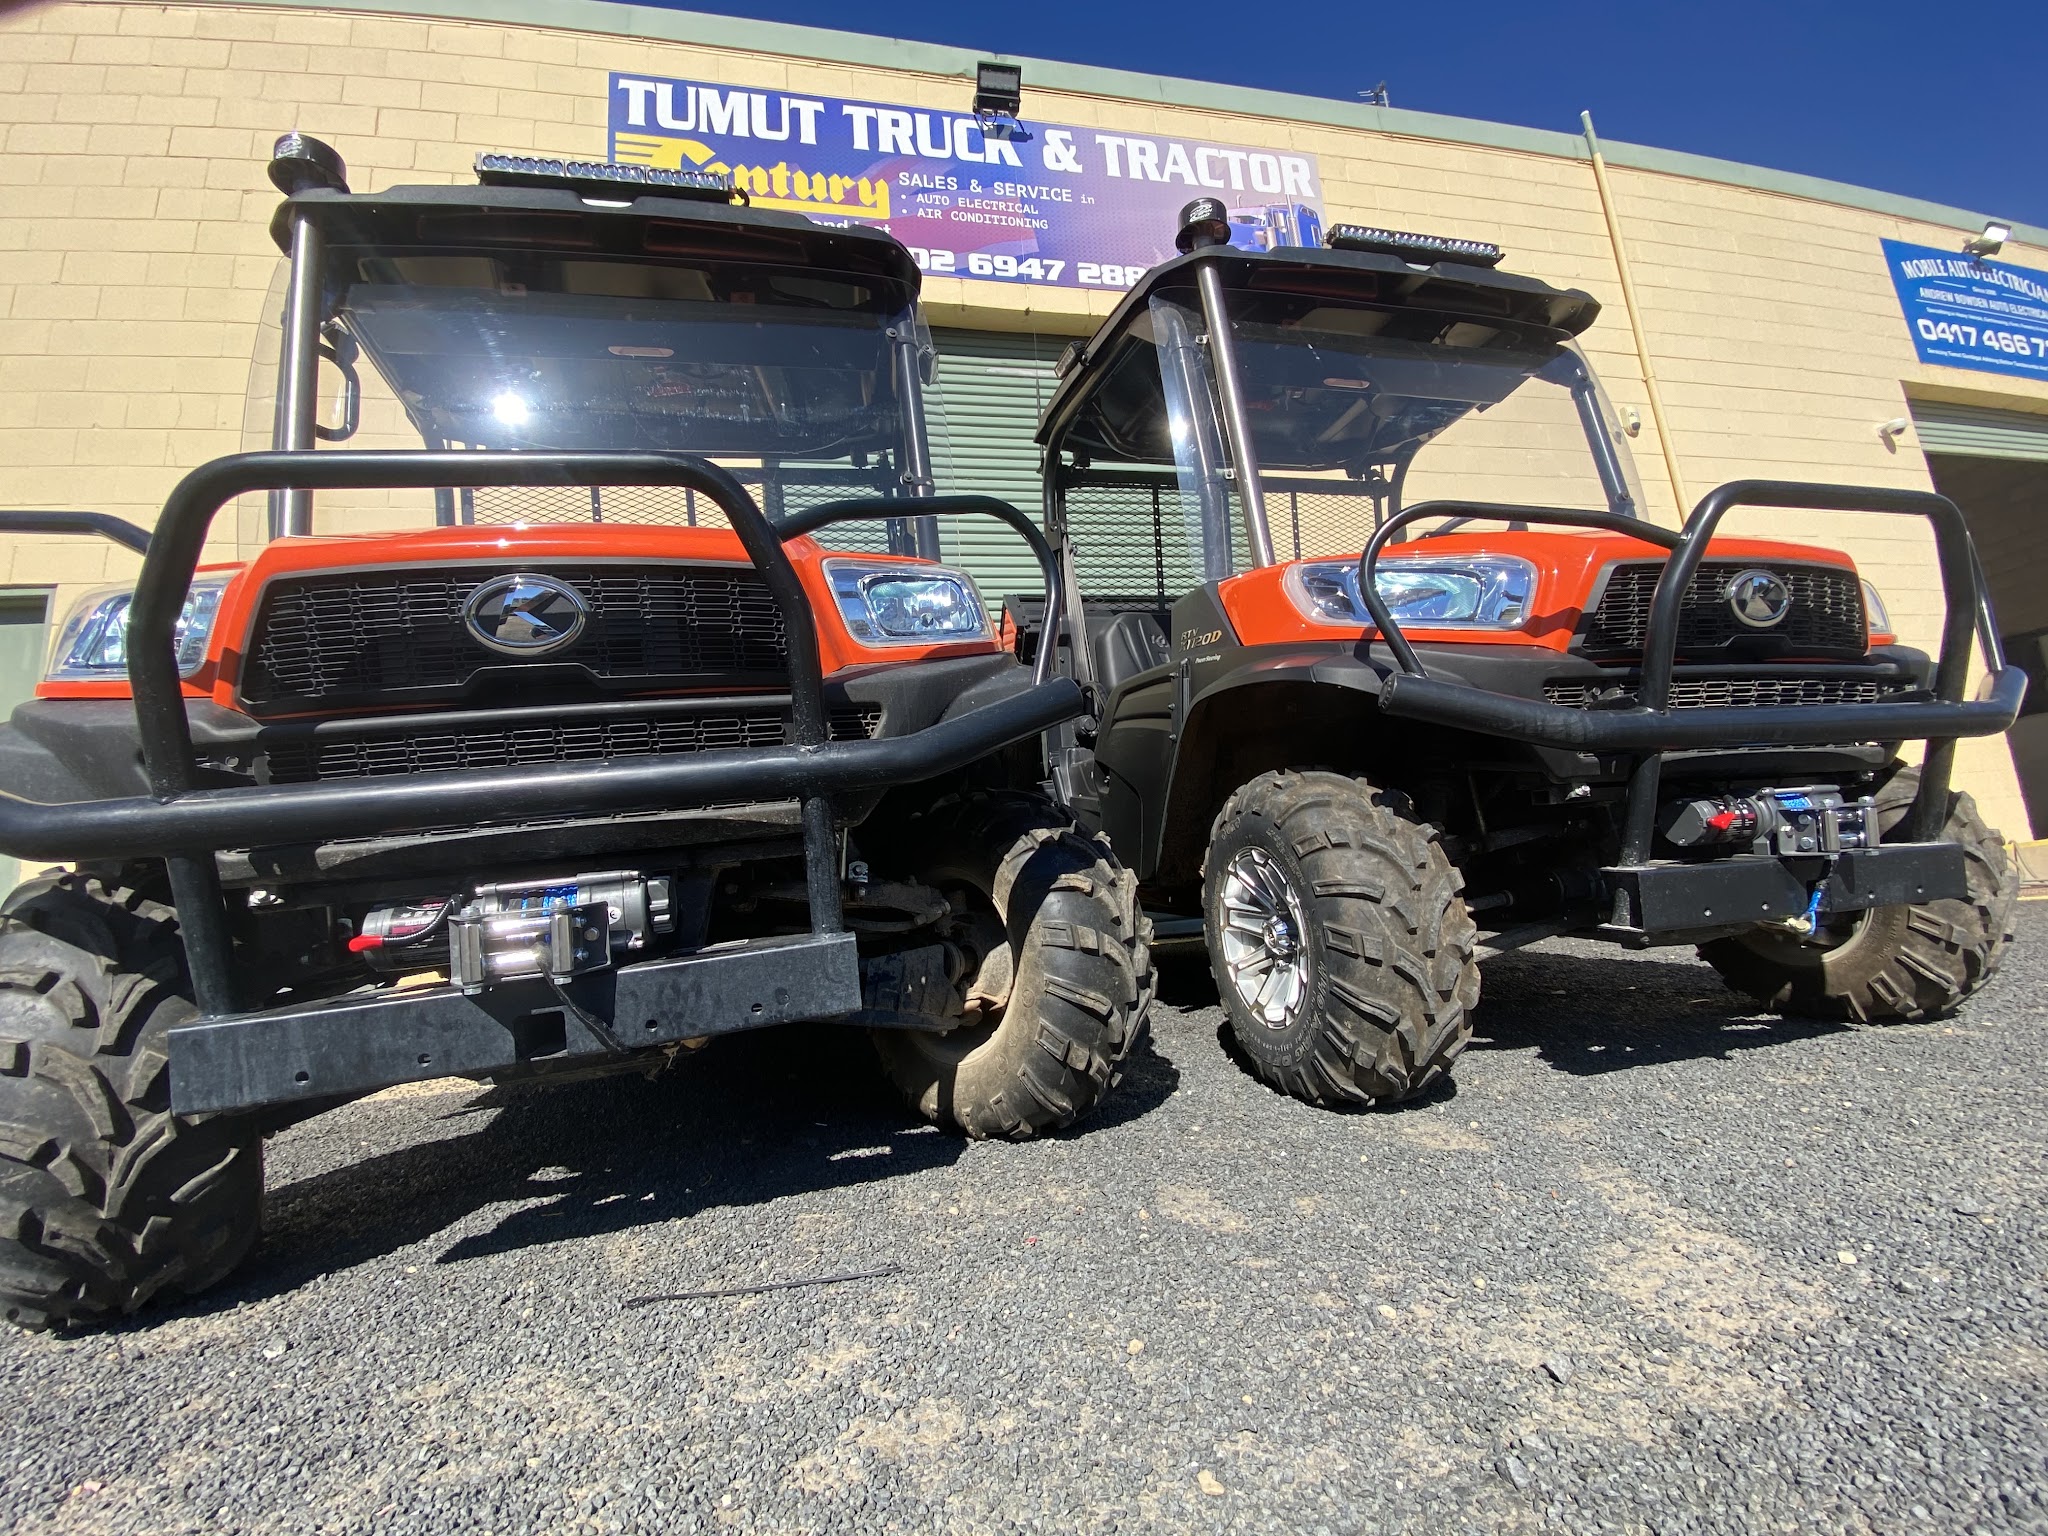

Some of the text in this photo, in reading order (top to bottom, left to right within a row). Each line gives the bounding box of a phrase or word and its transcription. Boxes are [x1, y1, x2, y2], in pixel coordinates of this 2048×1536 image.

[618, 79, 1316, 197] TUMUT TRUCK & TRACTOR
[899, 172, 1095, 205] SALES & SERVICE in
[916, 193, 1039, 215] AUTO ELECTRICAL
[917, 207, 1048, 230] AIR CONDITIONING
[906, 246, 956, 272] 02
[968, 253, 1065, 281] 6947
[1901, 259, 1948, 279] MOBILE
[1947, 260, 1981, 279] AUTO
[1917, 318, 1977, 347] 0417
[1982, 329, 2031, 356] 466
[1181, 627, 1199, 641] RTV
